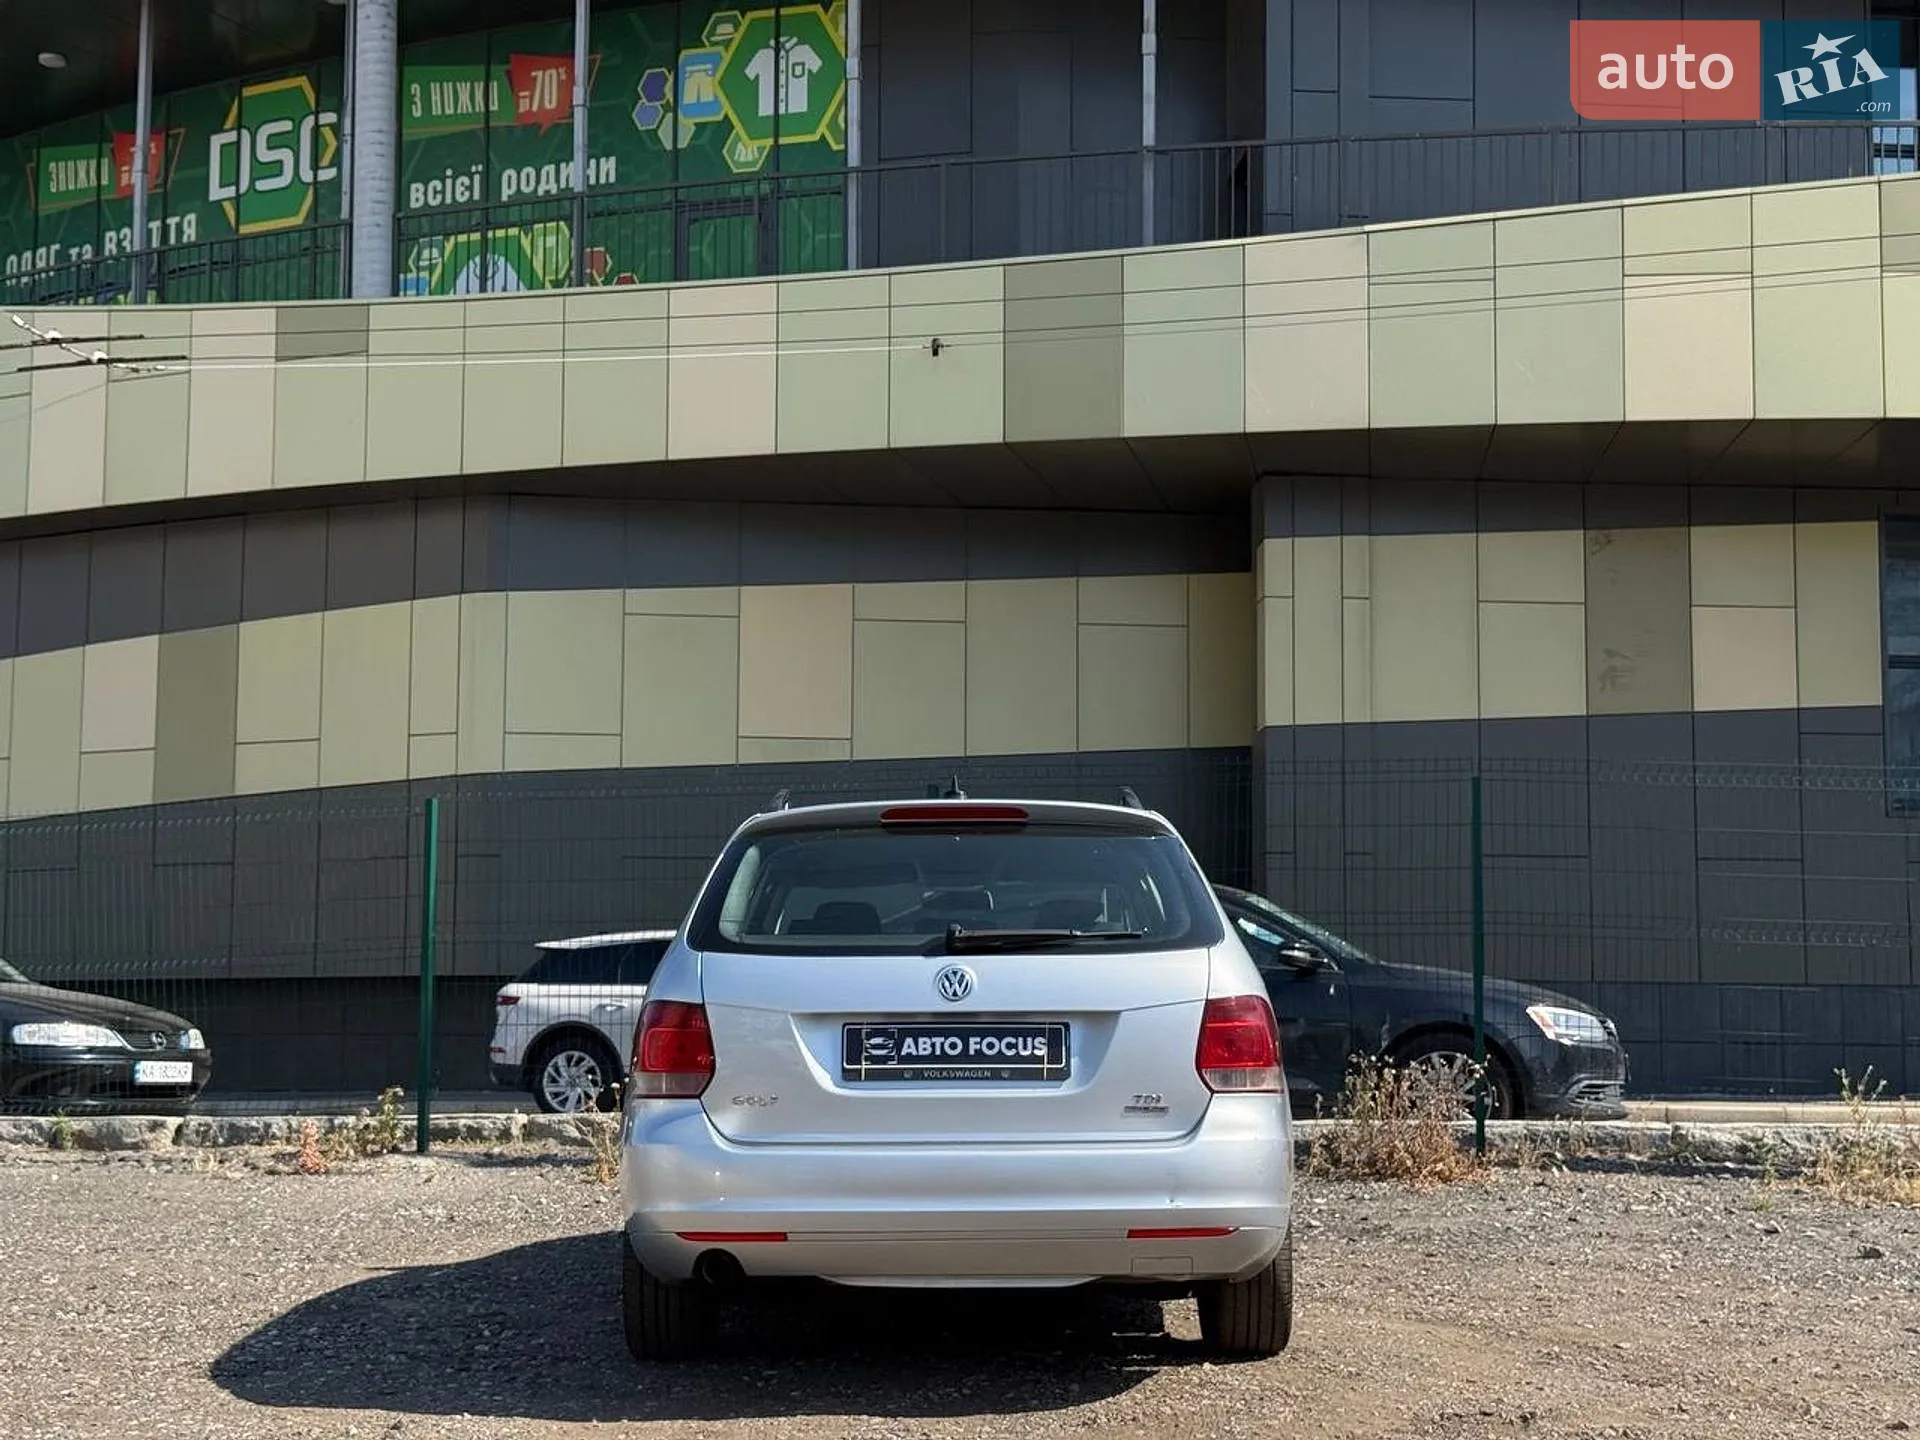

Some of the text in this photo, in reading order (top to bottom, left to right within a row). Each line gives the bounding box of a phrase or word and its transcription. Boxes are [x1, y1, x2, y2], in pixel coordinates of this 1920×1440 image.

[209, 111, 338, 202] DSC
[409, 163, 484, 209] всієї
[104, 213, 197, 264] ВЗТТЯ
[968, 1036, 1048, 1056] FOCUS
[922, 1069, 992, 1079] VOLKSWAGEN
